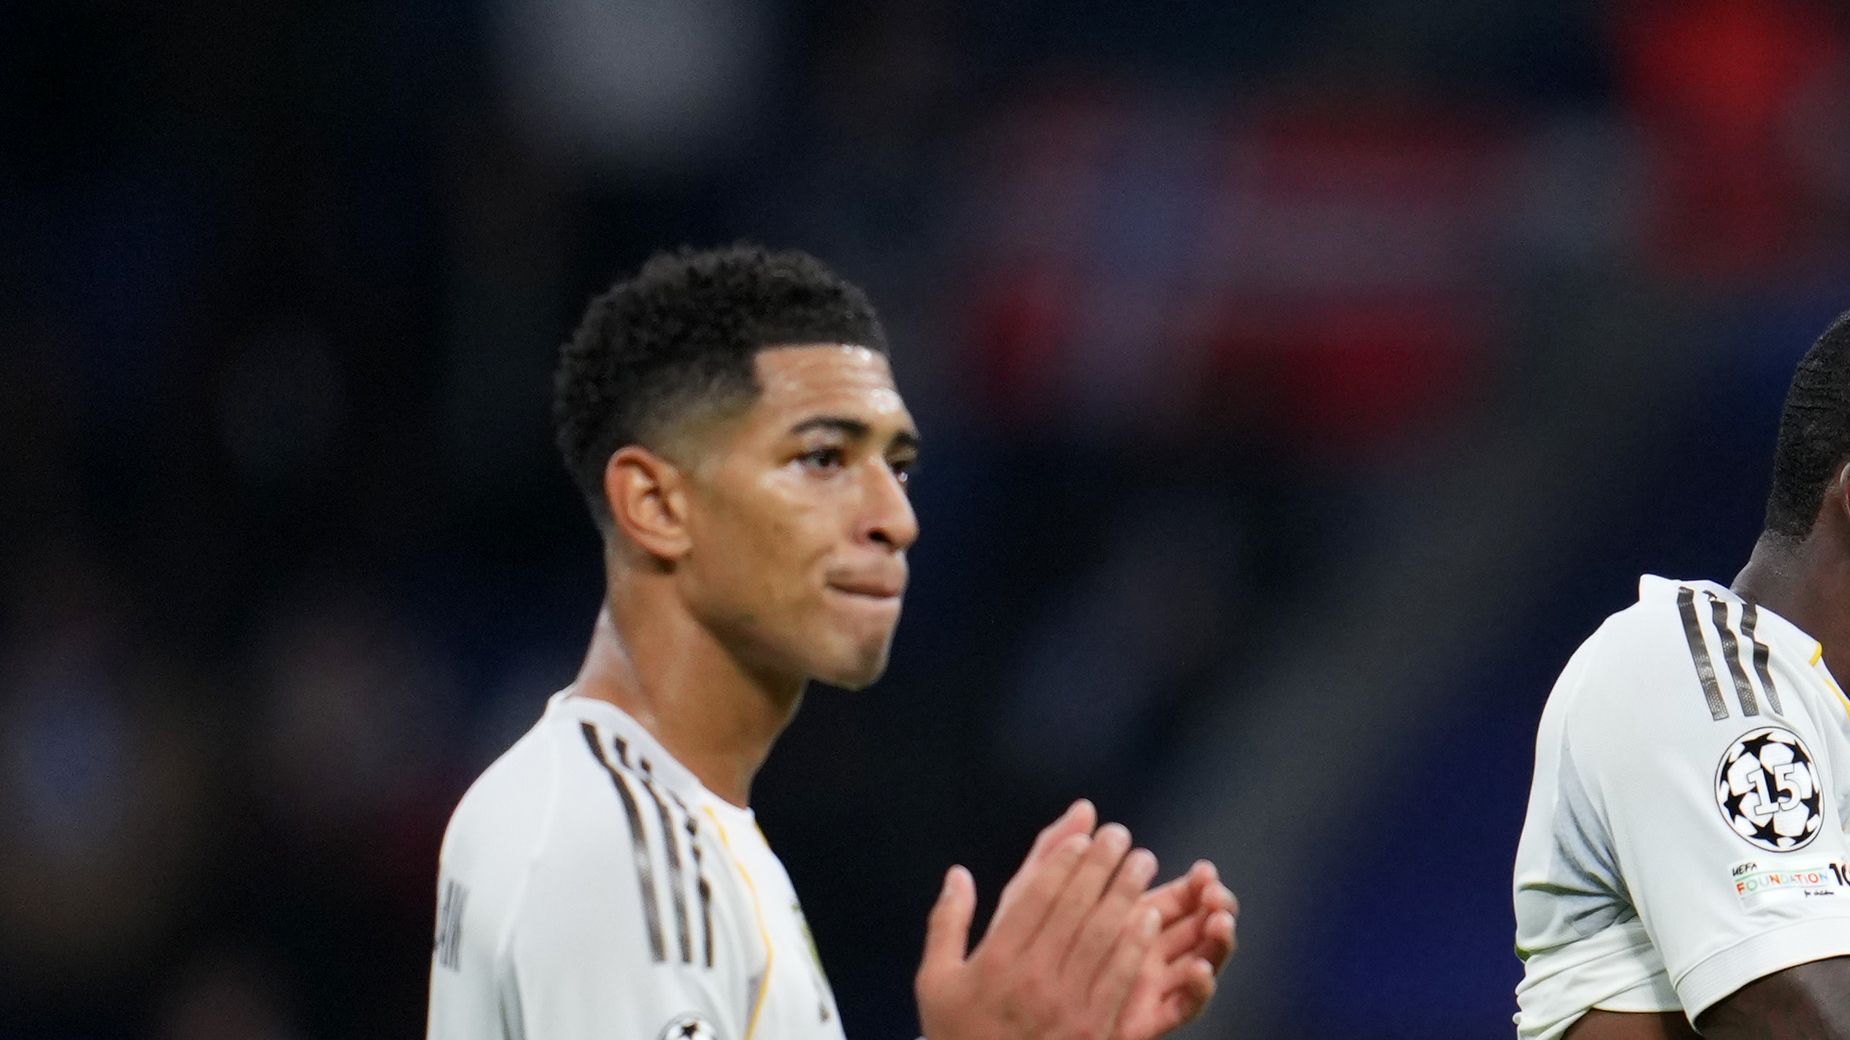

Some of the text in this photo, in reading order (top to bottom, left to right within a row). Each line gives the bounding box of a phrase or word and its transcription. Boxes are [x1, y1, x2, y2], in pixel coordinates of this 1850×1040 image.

[1746, 762, 1801, 816] 15
[1732, 863, 1757, 876] UEFA
[1736, 871, 1828, 896] FOUNDATION
